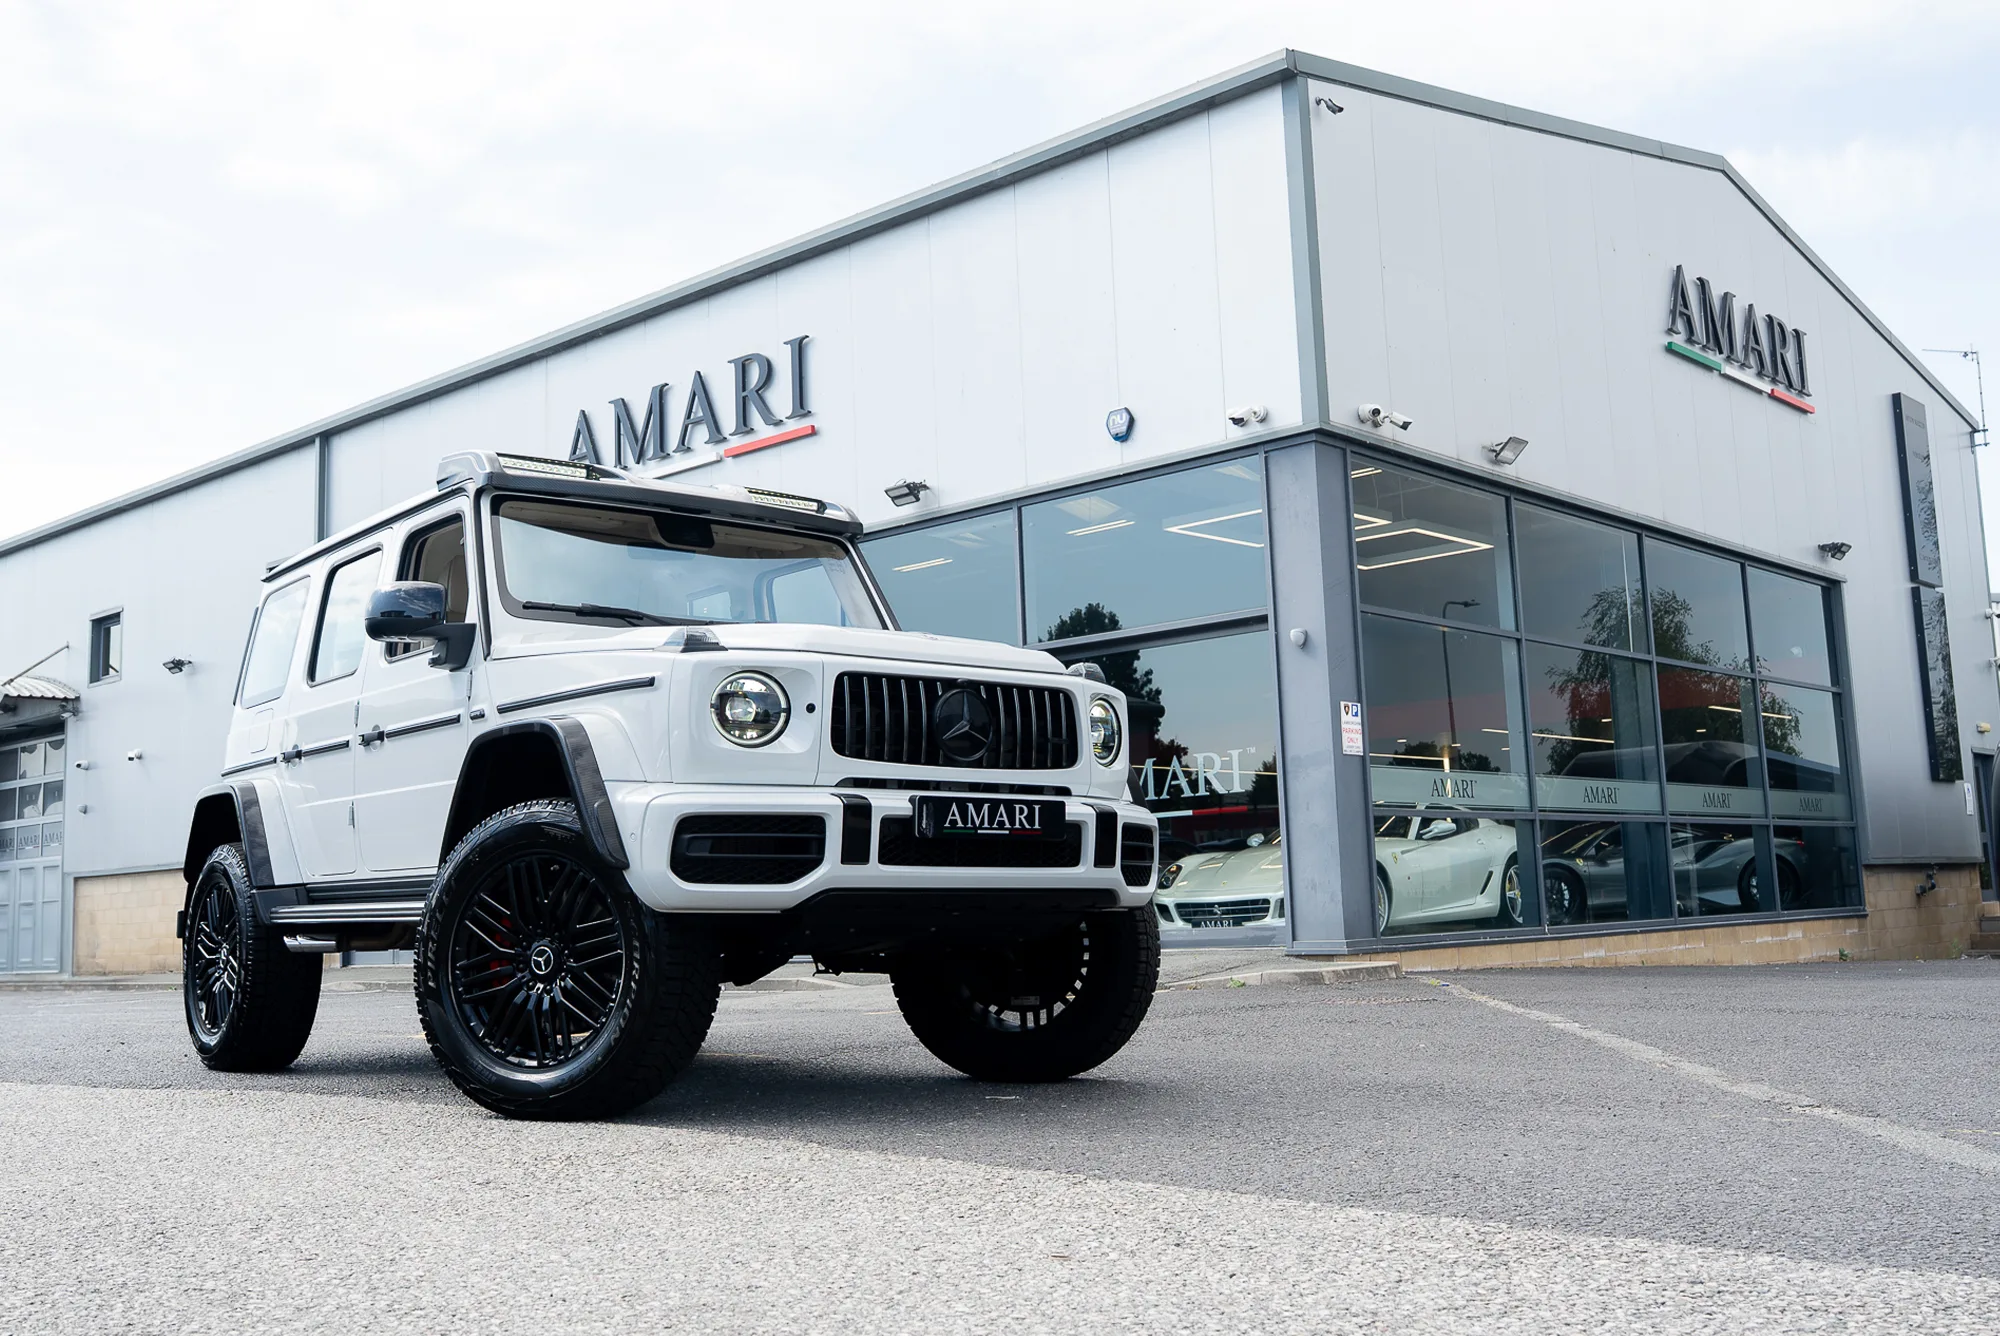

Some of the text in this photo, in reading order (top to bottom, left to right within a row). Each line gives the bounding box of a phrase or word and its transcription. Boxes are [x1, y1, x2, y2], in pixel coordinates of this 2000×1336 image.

[1667, 264, 1812, 397] AMARI
[568, 335, 811, 469] AMARI
[1342, 727, 1362, 736] PARKING
[1431, 778, 1475, 799] AMARI
[1583, 785, 1618, 804] AMARI
[1702, 792, 1731, 809] AMARI
[1799, 797, 1823, 813] AMARI
[944, 802, 1041, 829] AMARI
[1200, 920, 1234, 928] AMARI
